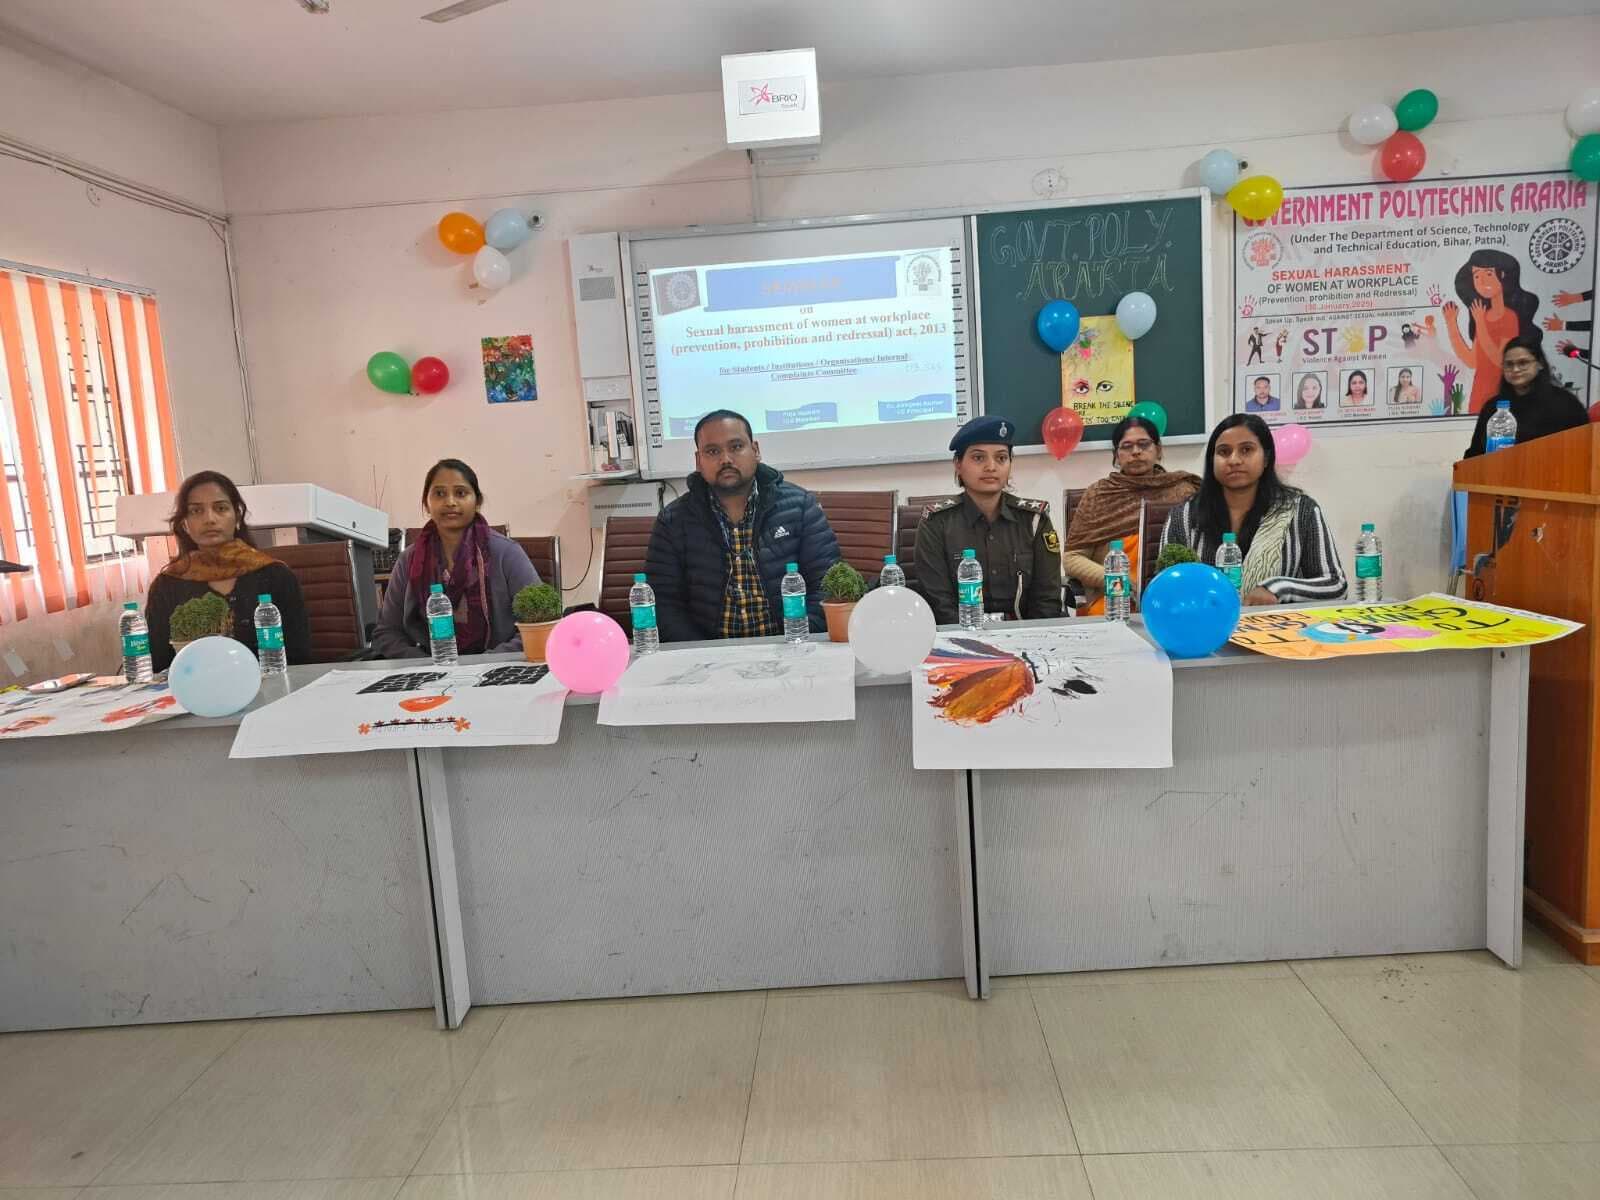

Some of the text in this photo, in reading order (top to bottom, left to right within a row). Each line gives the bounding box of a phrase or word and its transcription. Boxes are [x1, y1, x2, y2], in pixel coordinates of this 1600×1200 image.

[771, 93, 798, 103] BRIO
[1243, 180, 1587, 227] VERNMENT POLYTECHNIC ARARIA
[1290, 221, 1530, 246] (Under The Department of Science, Technology
[1314, 244, 1333, 254] and
[1336, 242, 1383, 253] Technical
[1386, 238, 1441, 250] Education,
[1272, 263, 1412, 281] SEXUAL HARASSMENT
[1267, 275, 1419, 294] OF WOMEN AT WORKPLACE
[1309, 292, 1354, 304] prohibition
[1356, 291, 1371, 300] and
[686, 310, 931, 338] Sexual harassment of women at workplace
[743, 334, 809, 351] prohibition
[811, 331, 832, 343] and
[836, 326, 892, 341] redressal)
[920, 322, 947, 335] 2013
